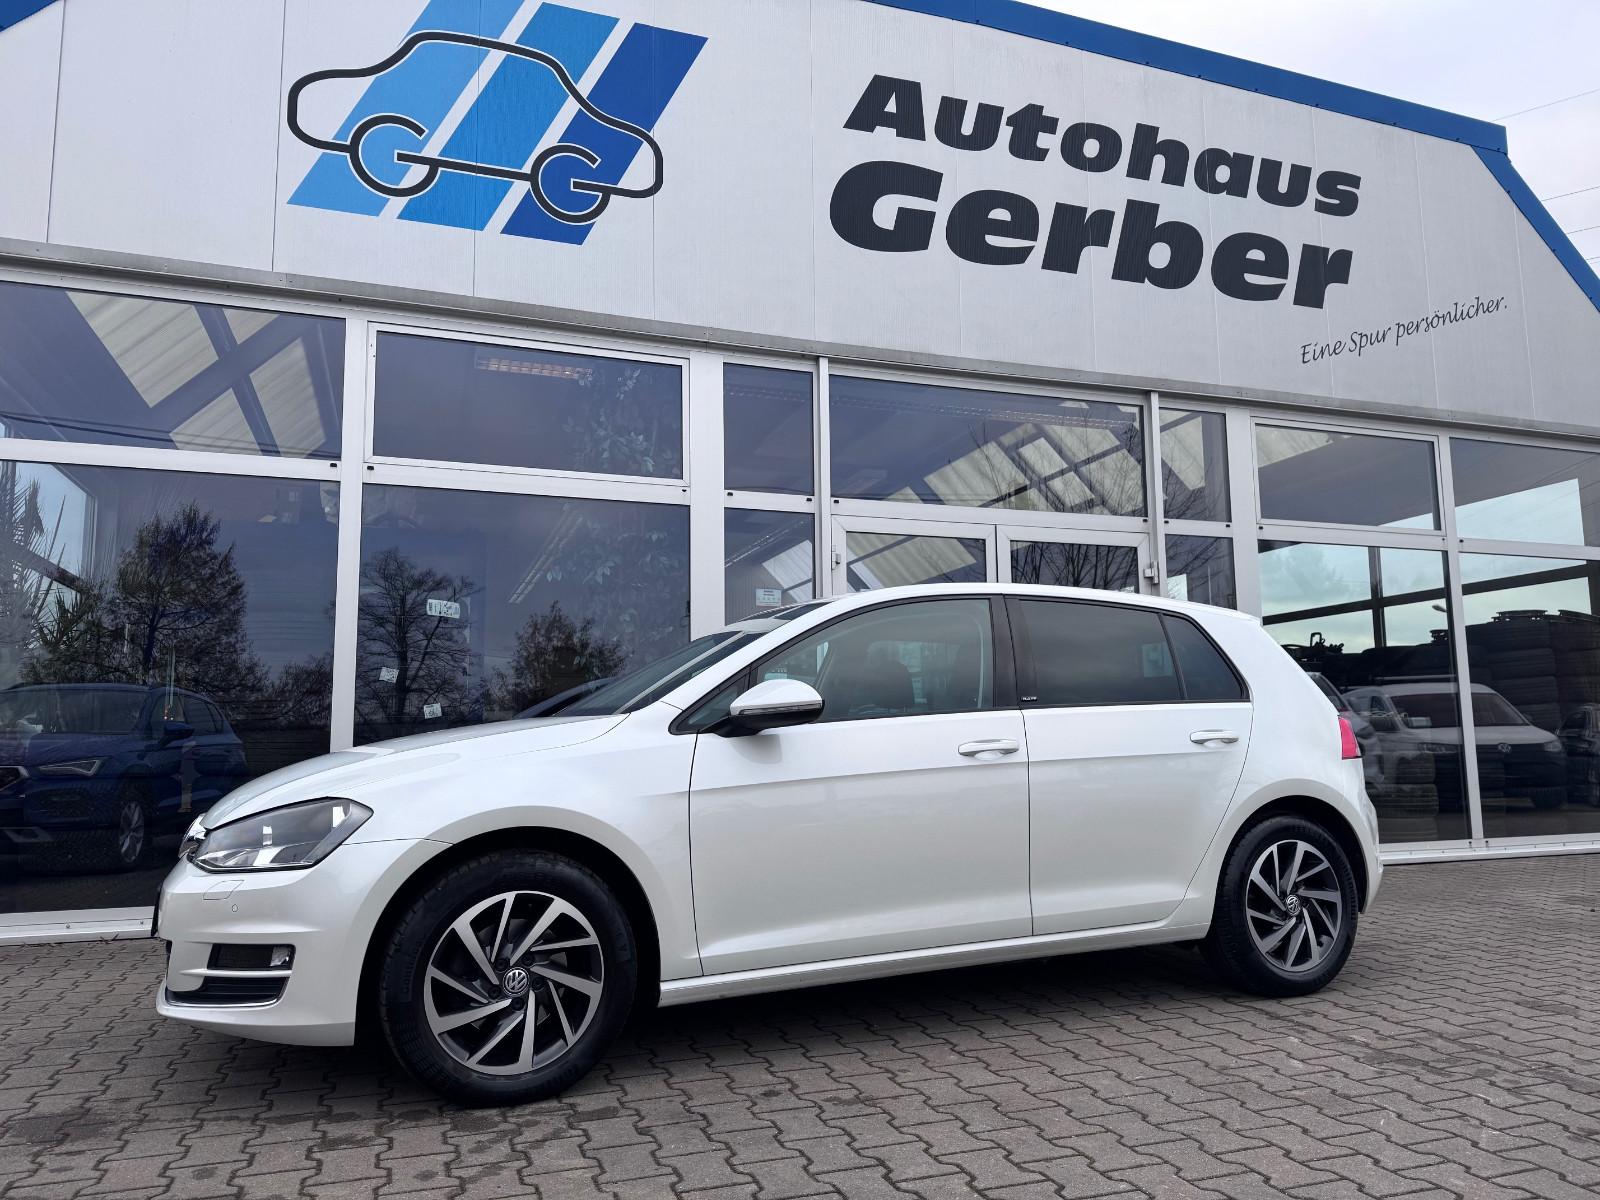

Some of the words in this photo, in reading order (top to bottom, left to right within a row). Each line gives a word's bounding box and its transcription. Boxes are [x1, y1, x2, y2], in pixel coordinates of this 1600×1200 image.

[843, 74, 1362, 217] Autohaus
[830, 160, 1353, 310] Gerber
[1300, 340, 1347, 364] Eine
[1349, 326, 1391, 357] Spur
[1395, 296, 1508, 346] persönlicher.
